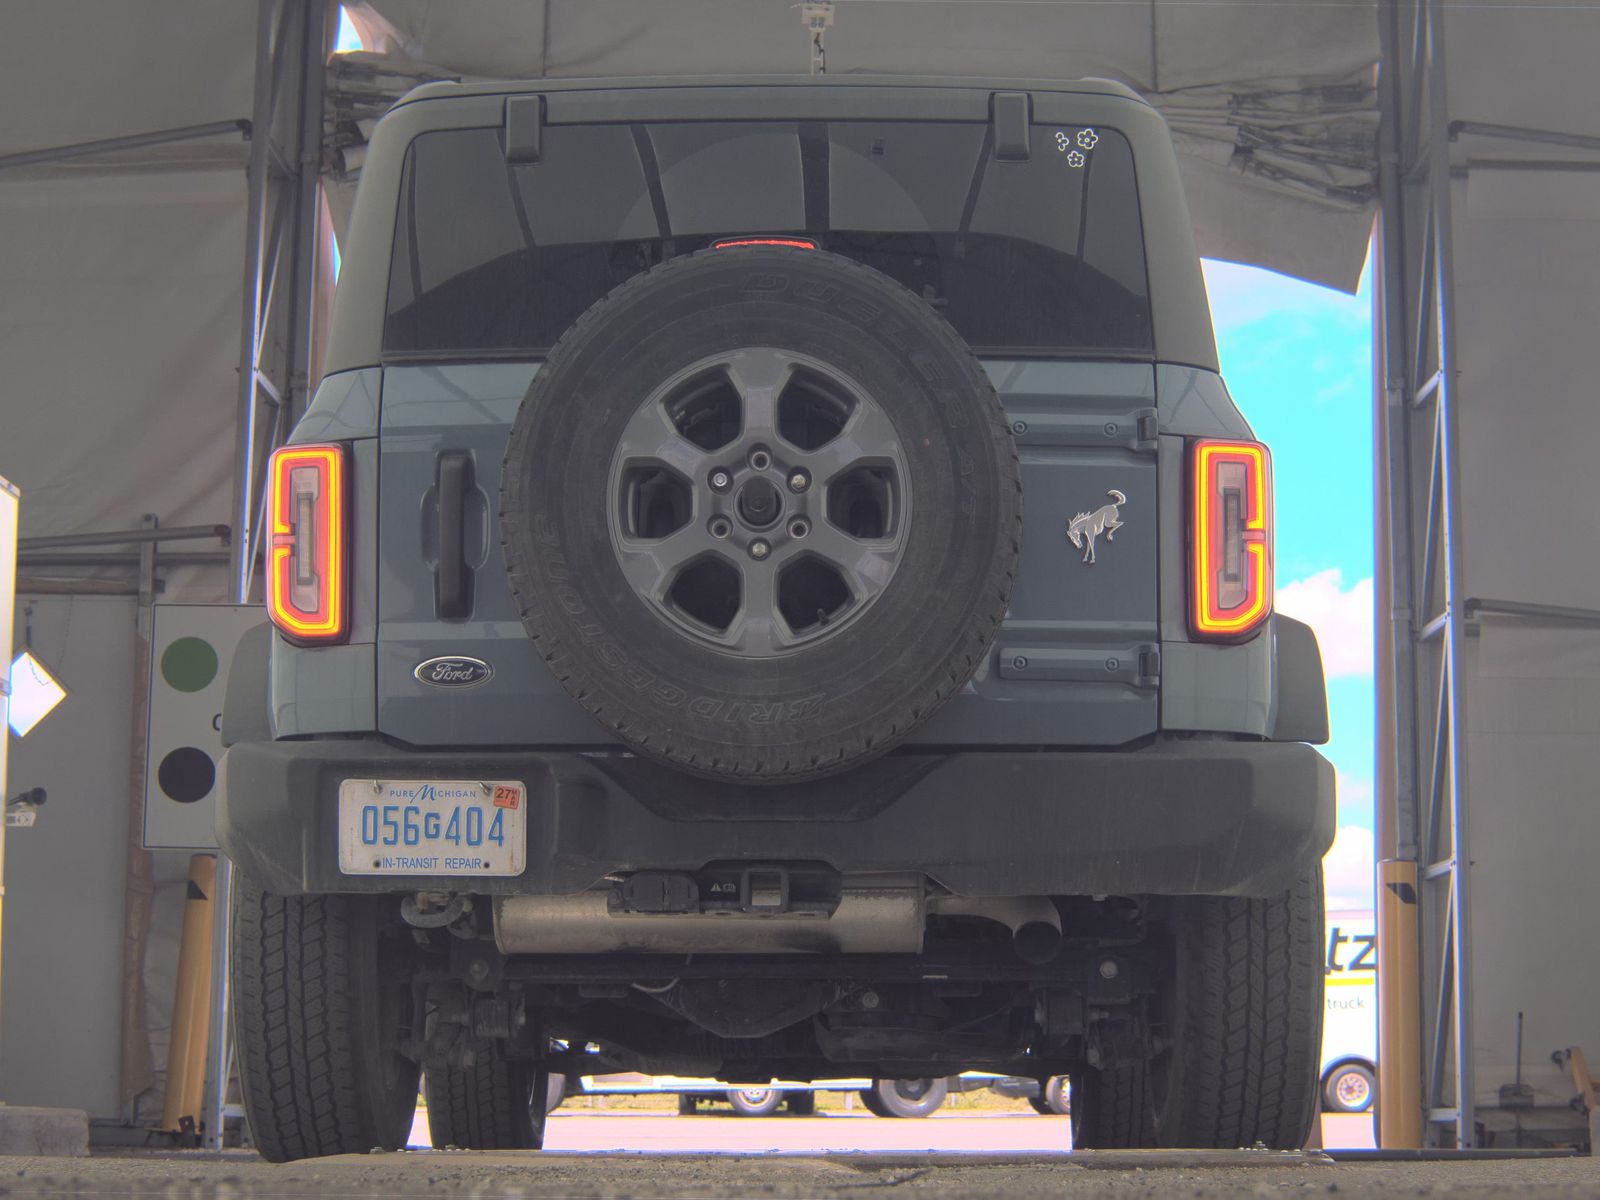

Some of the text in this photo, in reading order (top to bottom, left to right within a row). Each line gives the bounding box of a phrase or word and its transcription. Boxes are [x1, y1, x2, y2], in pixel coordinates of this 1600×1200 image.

[742, 272, 972, 430] DUELER
[534, 512, 828, 725] BRIDGESTONE
[432, 662, 474, 681] Ford
[390, 784, 476, 803] PURE MICHIGAN
[496, 787, 512, 799] 27
[361, 805, 505, 847] 056G404
[382, 857, 482, 869] IN-TRANSIT REPAIR
[1325, 926, 1378, 976] tz
[1327, 996, 1365, 1010] truck
